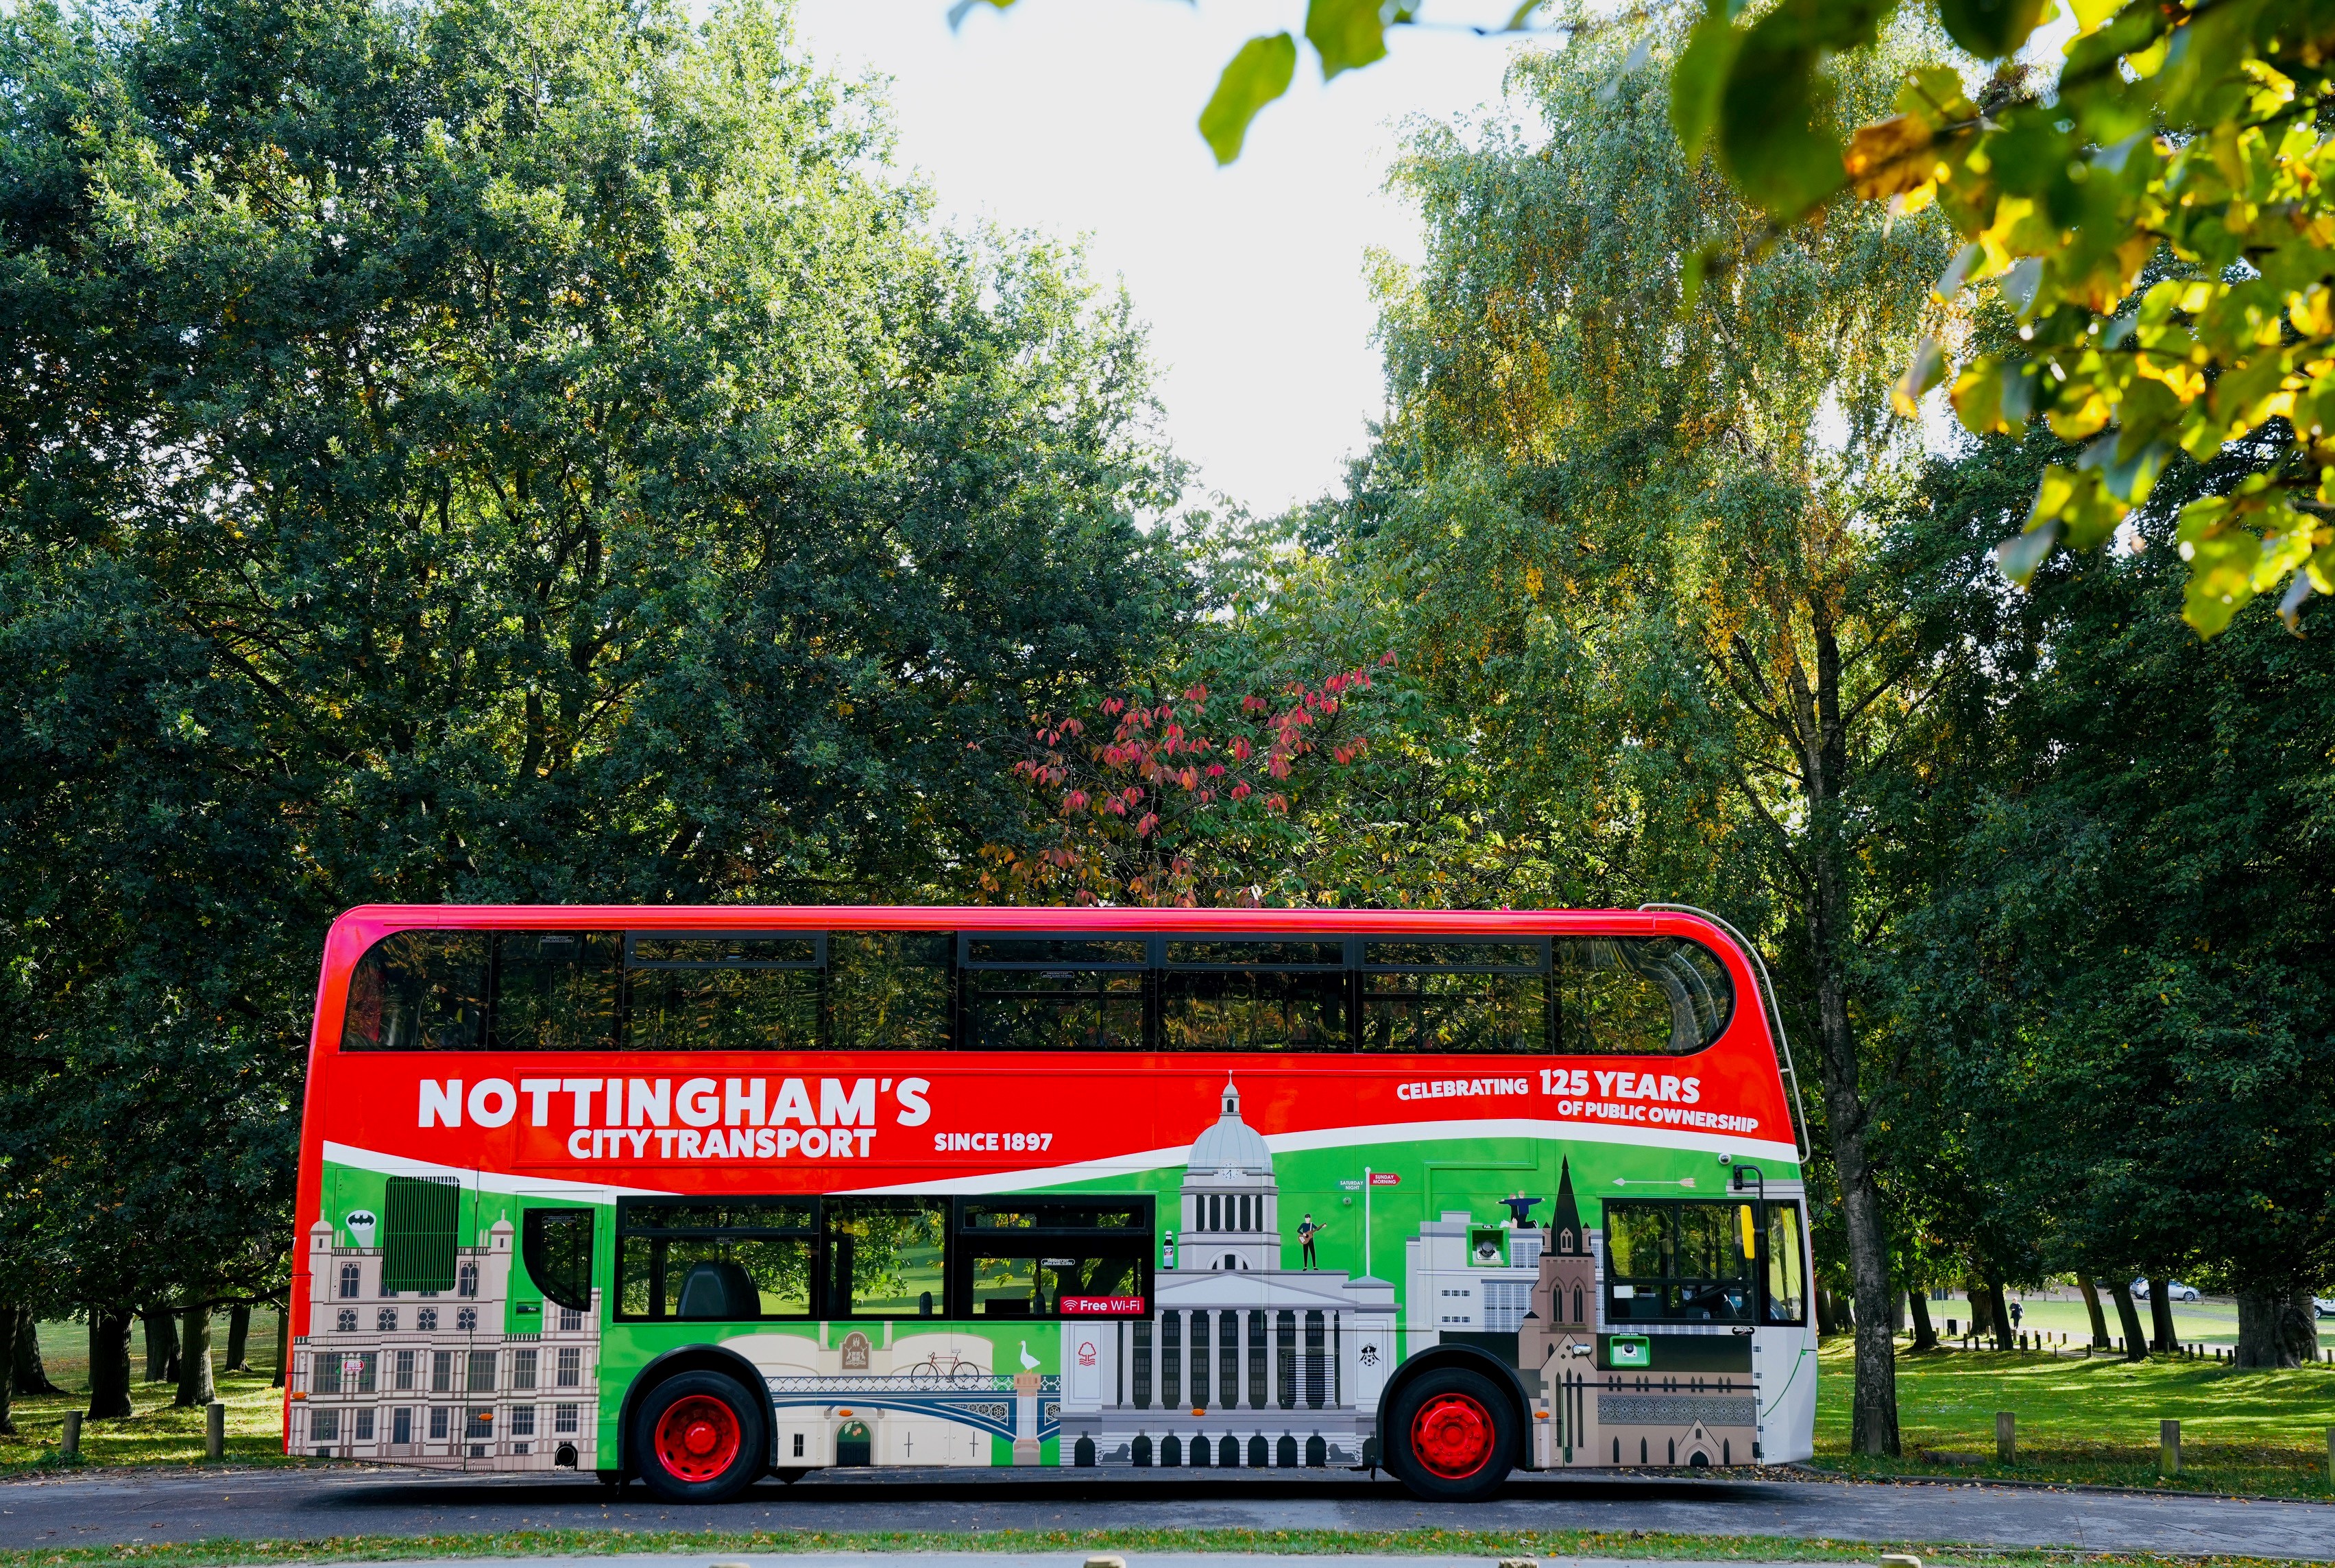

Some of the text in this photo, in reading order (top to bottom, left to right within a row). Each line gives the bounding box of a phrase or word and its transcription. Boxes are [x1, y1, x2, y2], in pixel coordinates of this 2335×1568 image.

[1397, 1069, 1701, 1103] CELEBRATING 125 YEARS
[419, 1077, 930, 1128] NOTTINGHAM'S
[1558, 1100, 1759, 1133] OF PUBLIC OWNERSHIP
[568, 1129, 876, 1159] CITY TRANSPORT
[934, 1133, 1053, 1152] SINCE 1897
[1080, 1300, 1140, 1311] Free Wi-Fi
